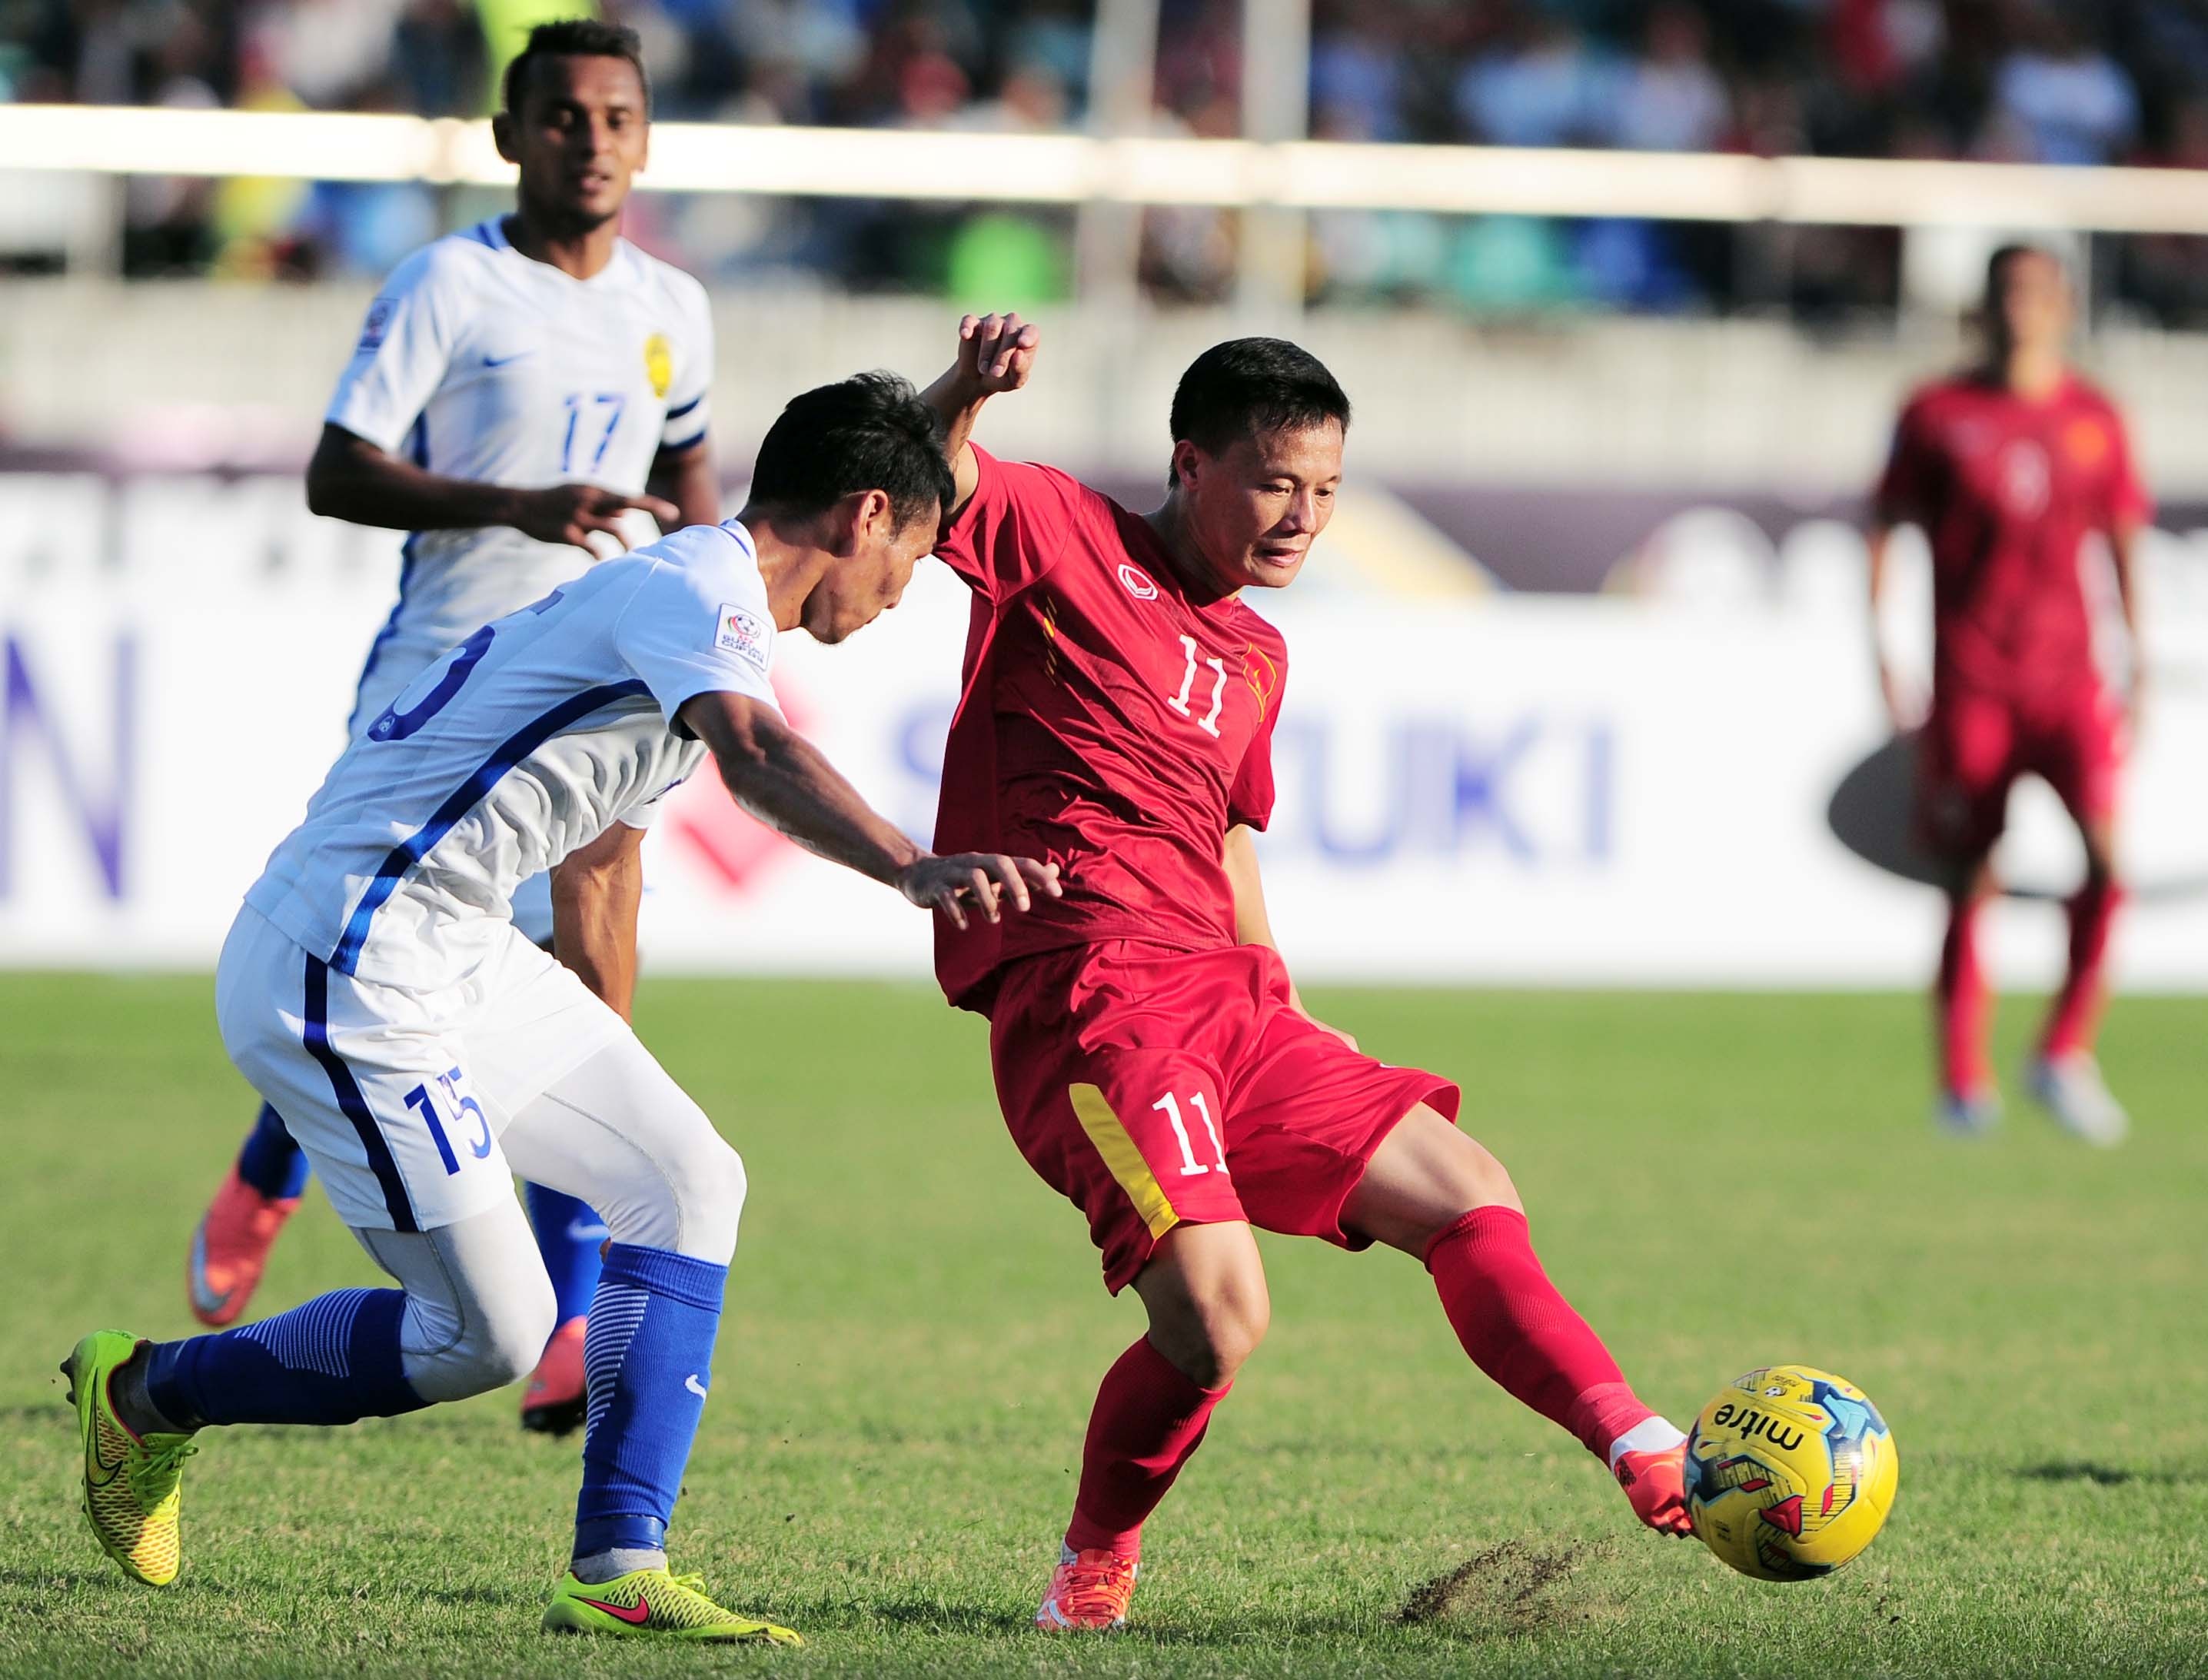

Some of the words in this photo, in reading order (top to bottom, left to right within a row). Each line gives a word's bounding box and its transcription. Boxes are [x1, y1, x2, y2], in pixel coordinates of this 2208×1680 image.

[561, 392, 627, 473] 17
[1168, 634, 1228, 739] 11
[403, 1066, 492, 1176] 15
[1152, 1090, 1230, 1176] 11
[1714, 1403, 1804, 1451] mitre
